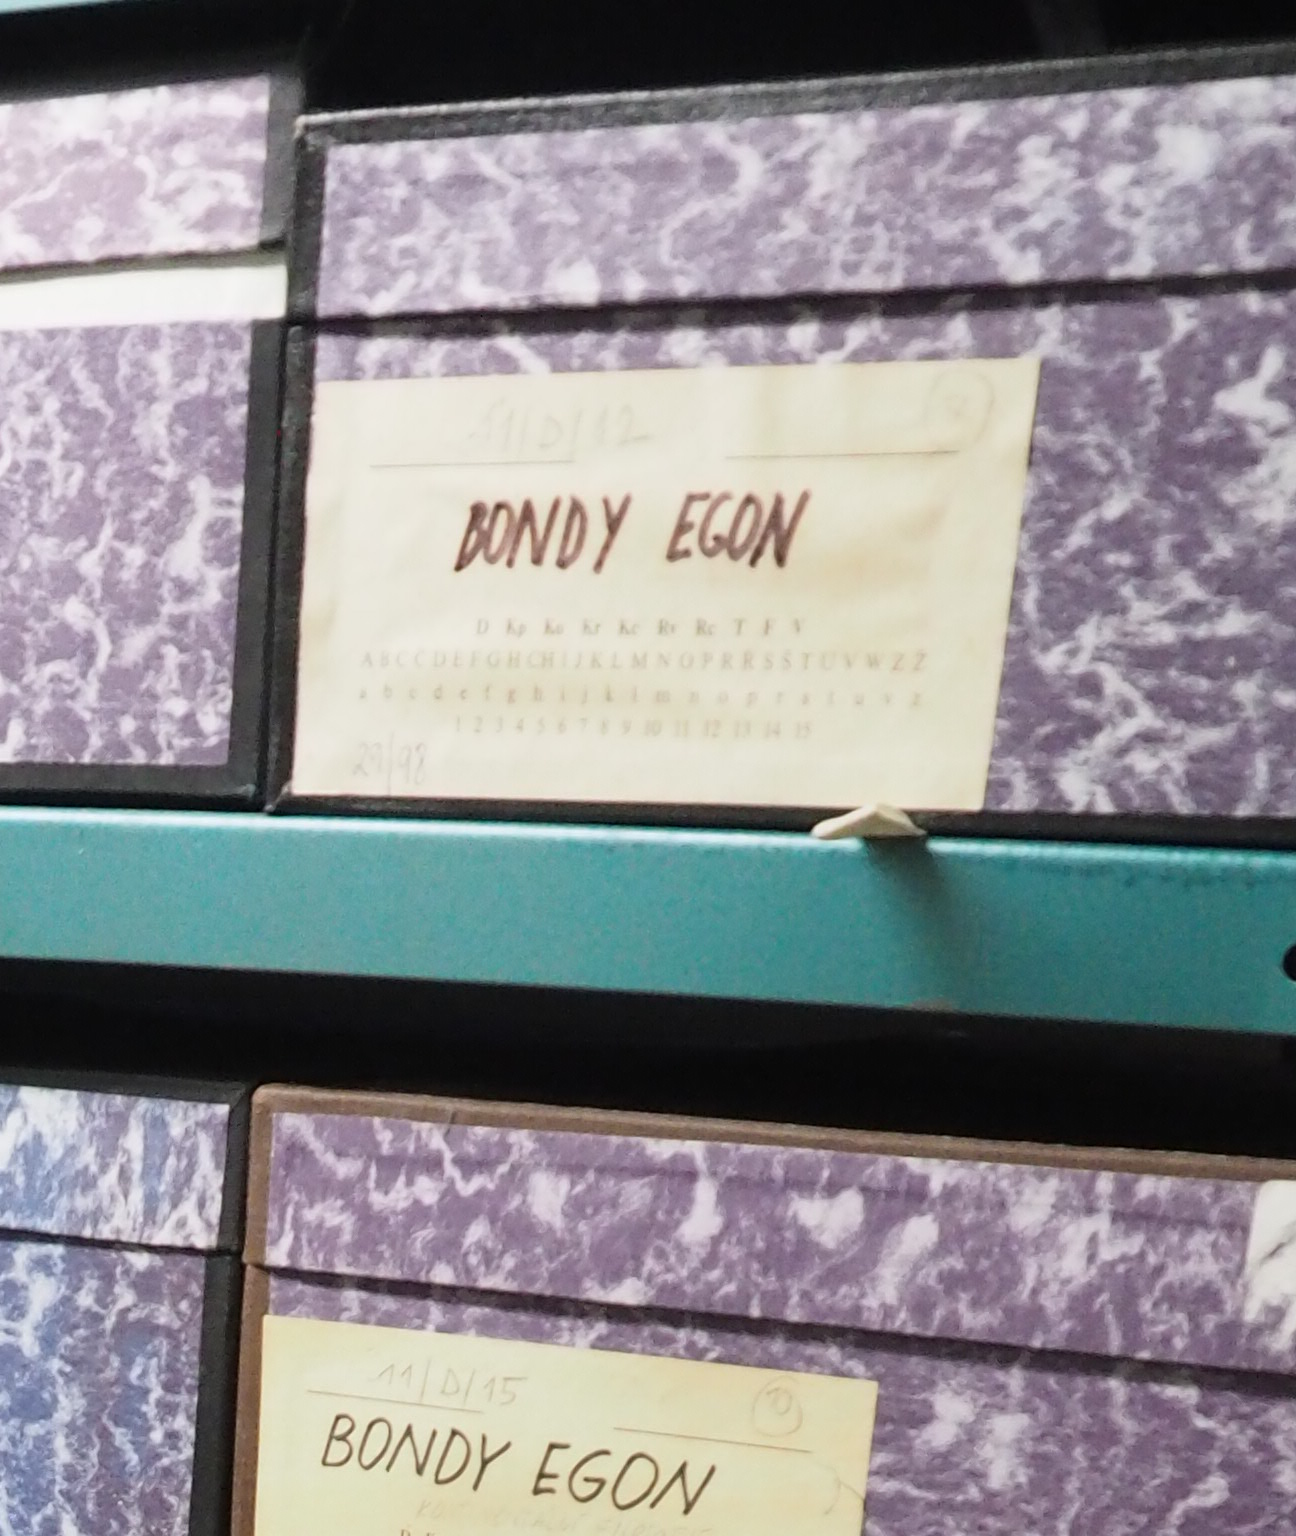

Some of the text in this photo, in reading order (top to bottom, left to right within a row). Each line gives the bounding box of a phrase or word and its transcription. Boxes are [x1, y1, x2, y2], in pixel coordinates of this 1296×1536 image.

[453, 489, 811, 574] BONDY EGON
[377, 1357, 530, 1406] 11/D/15
[320, 1413, 513, 1492] BONDY
[531, 1442, 716, 1516] EGON
